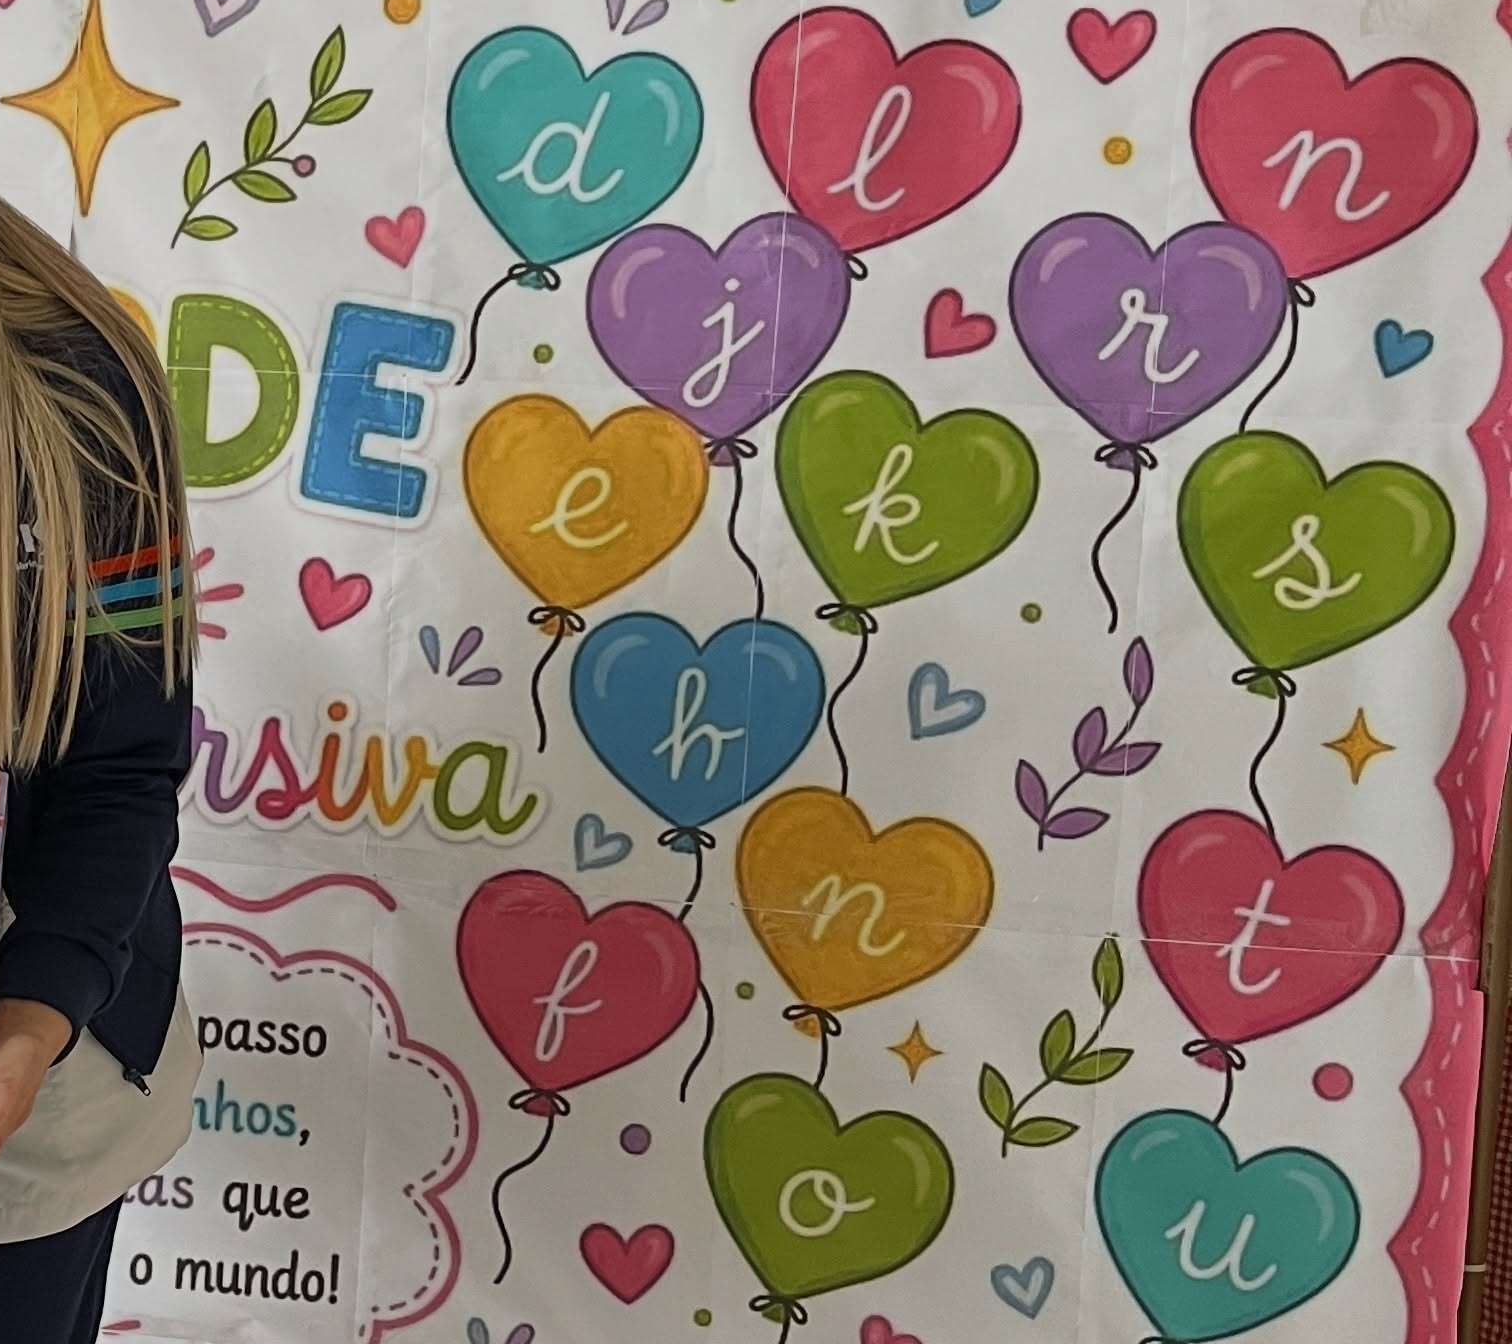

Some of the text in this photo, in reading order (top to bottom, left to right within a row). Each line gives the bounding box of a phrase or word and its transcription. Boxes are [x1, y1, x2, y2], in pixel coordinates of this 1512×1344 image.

[497, 92, 623, 202] d
[827, 85, 912, 211] l
[1262, 130, 1389, 221] n
[682, 278, 764, 408] j
[1098, 289, 1199, 382] r
[106, 286, 455, 519] DE
[530, 467, 627, 548] e
[844, 444, 937, 565] k
[1253, 514, 1362, 609] s
[651, 668, 745, 781] h
[803, 874, 906, 955] n
[1215, 879, 1289, 995] t
[197, 1015, 327, 1058] passo
[533, 940, 603, 1061] f
[223, 1182, 310, 1231] que
[779, 1168, 875, 1237] o
[1164, 1200, 1277, 1291] u
[129, 1249, 340, 1305] o mundo!
